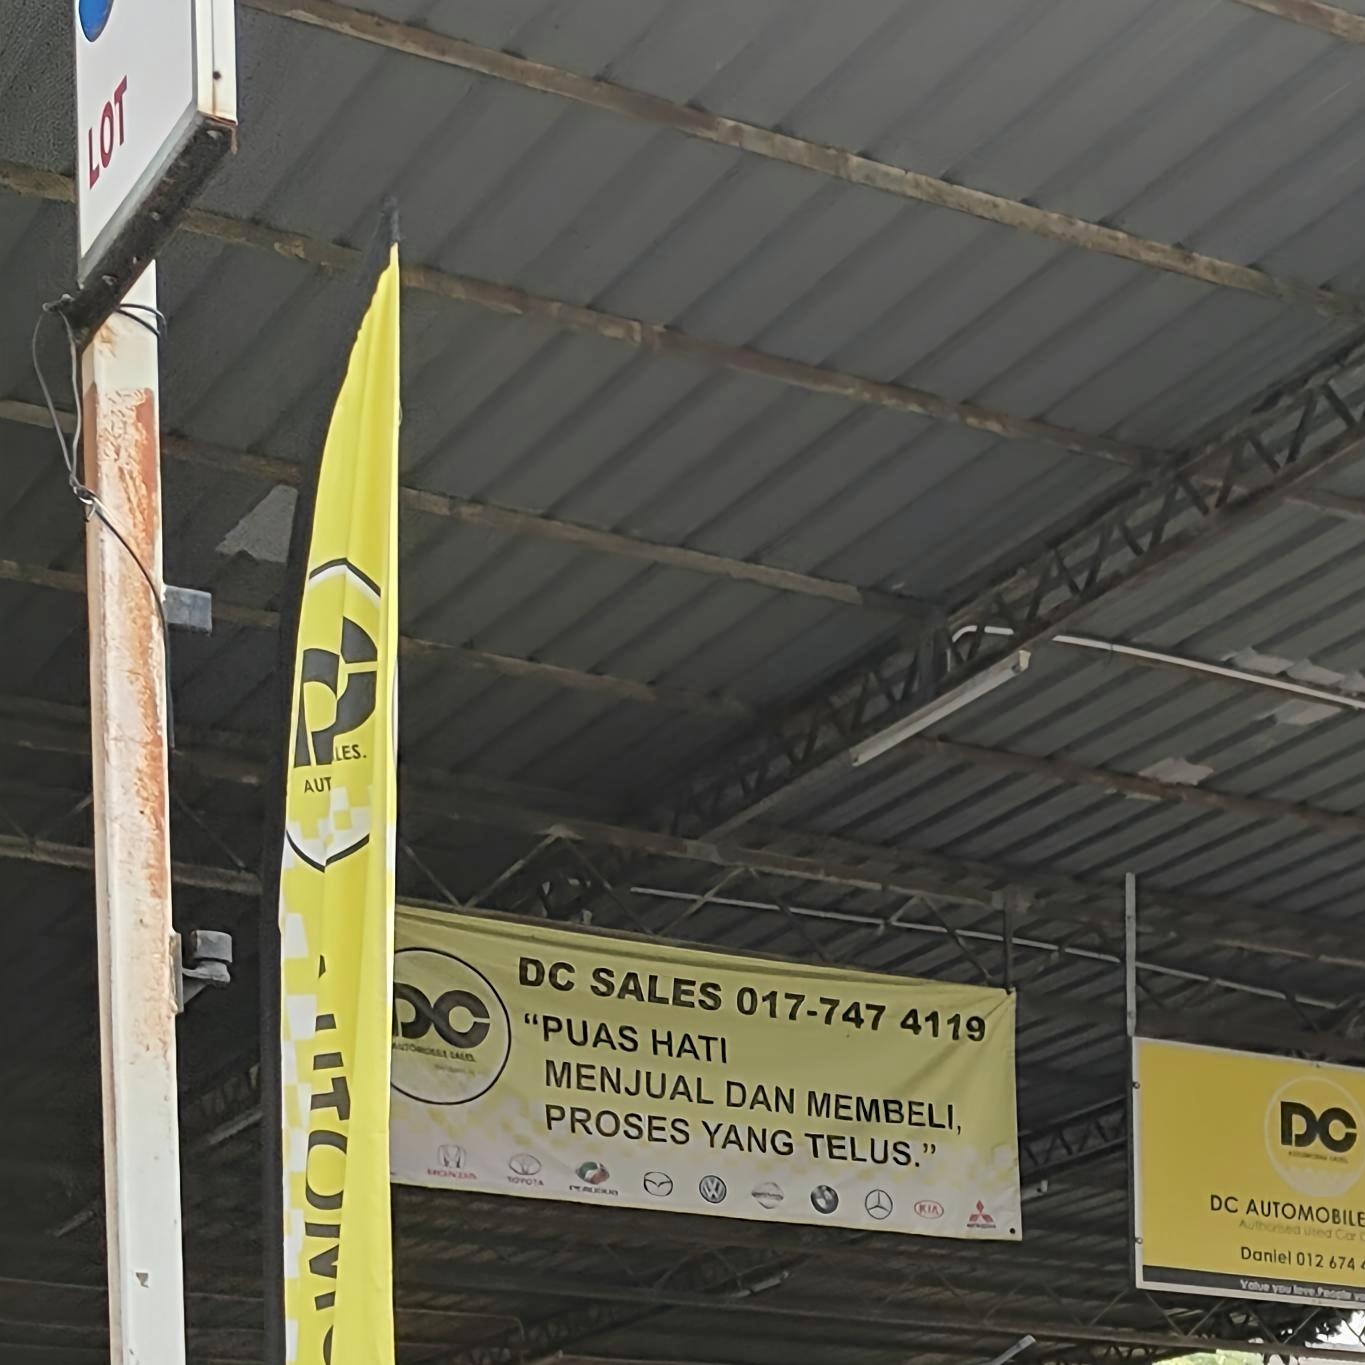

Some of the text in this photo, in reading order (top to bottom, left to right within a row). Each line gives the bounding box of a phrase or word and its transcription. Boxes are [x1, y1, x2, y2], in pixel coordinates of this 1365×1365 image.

[87, 74, 128, 191] LOT
[392, 982, 491, 1049] DC
[519, 956, 986, 1042] DC SALES 017-747 4119
[651, 1028, 728, 1064] HATI
[544, 1059, 962, 1136] MENJUAL DAN MEMBELI,
[544, 1103, 691, 1145] PROSES
[701, 1120, 795, 1157] YANG
[1280, 1100, 1357, 1153] DC
[917, 1203, 940, 1215] KIA
[1210, 1194, 1239, 1214] DC
[1246, 1198, 1365, 1228] AUTOMOBILE
[1241, 1246, 1291, 1265] Daniel
[1297, 1252, 1324, 1268] 012
[1329, 1256, 1355, 1271] 674
